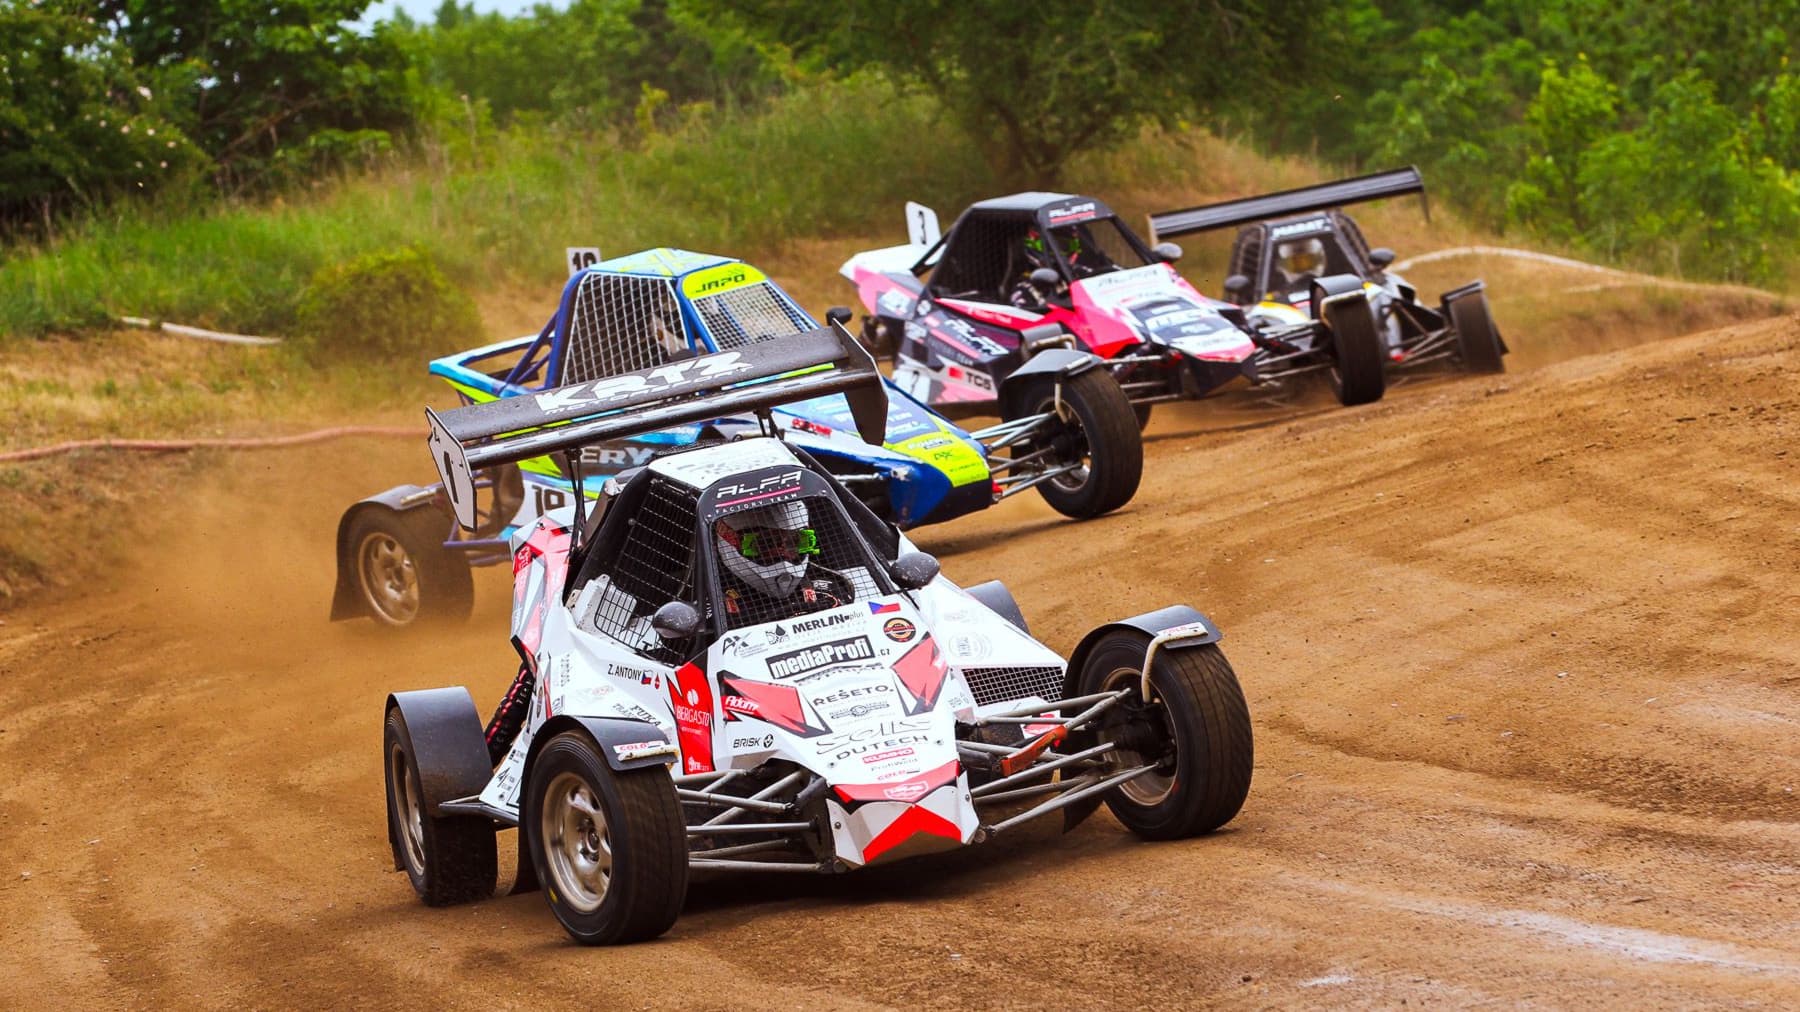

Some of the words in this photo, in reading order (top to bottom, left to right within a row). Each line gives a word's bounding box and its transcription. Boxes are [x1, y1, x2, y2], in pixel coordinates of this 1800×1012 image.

[695, 273, 746, 293] JAPO
[534, 351, 741, 411] KRTZ
[716, 470, 803, 500] ALFA
[532, 484, 566, 518] 10
[715, 500, 764, 515] FACTORY
[769, 493, 798, 504] TEAM
[769, 638, 873, 680] mediaProfi
[614, 664, 642, 681] ANTONY
[676, 705, 711, 727] BERGASTO
[732, 737, 761, 749] BRISK
[836, 735, 929, 760] DUTECH
